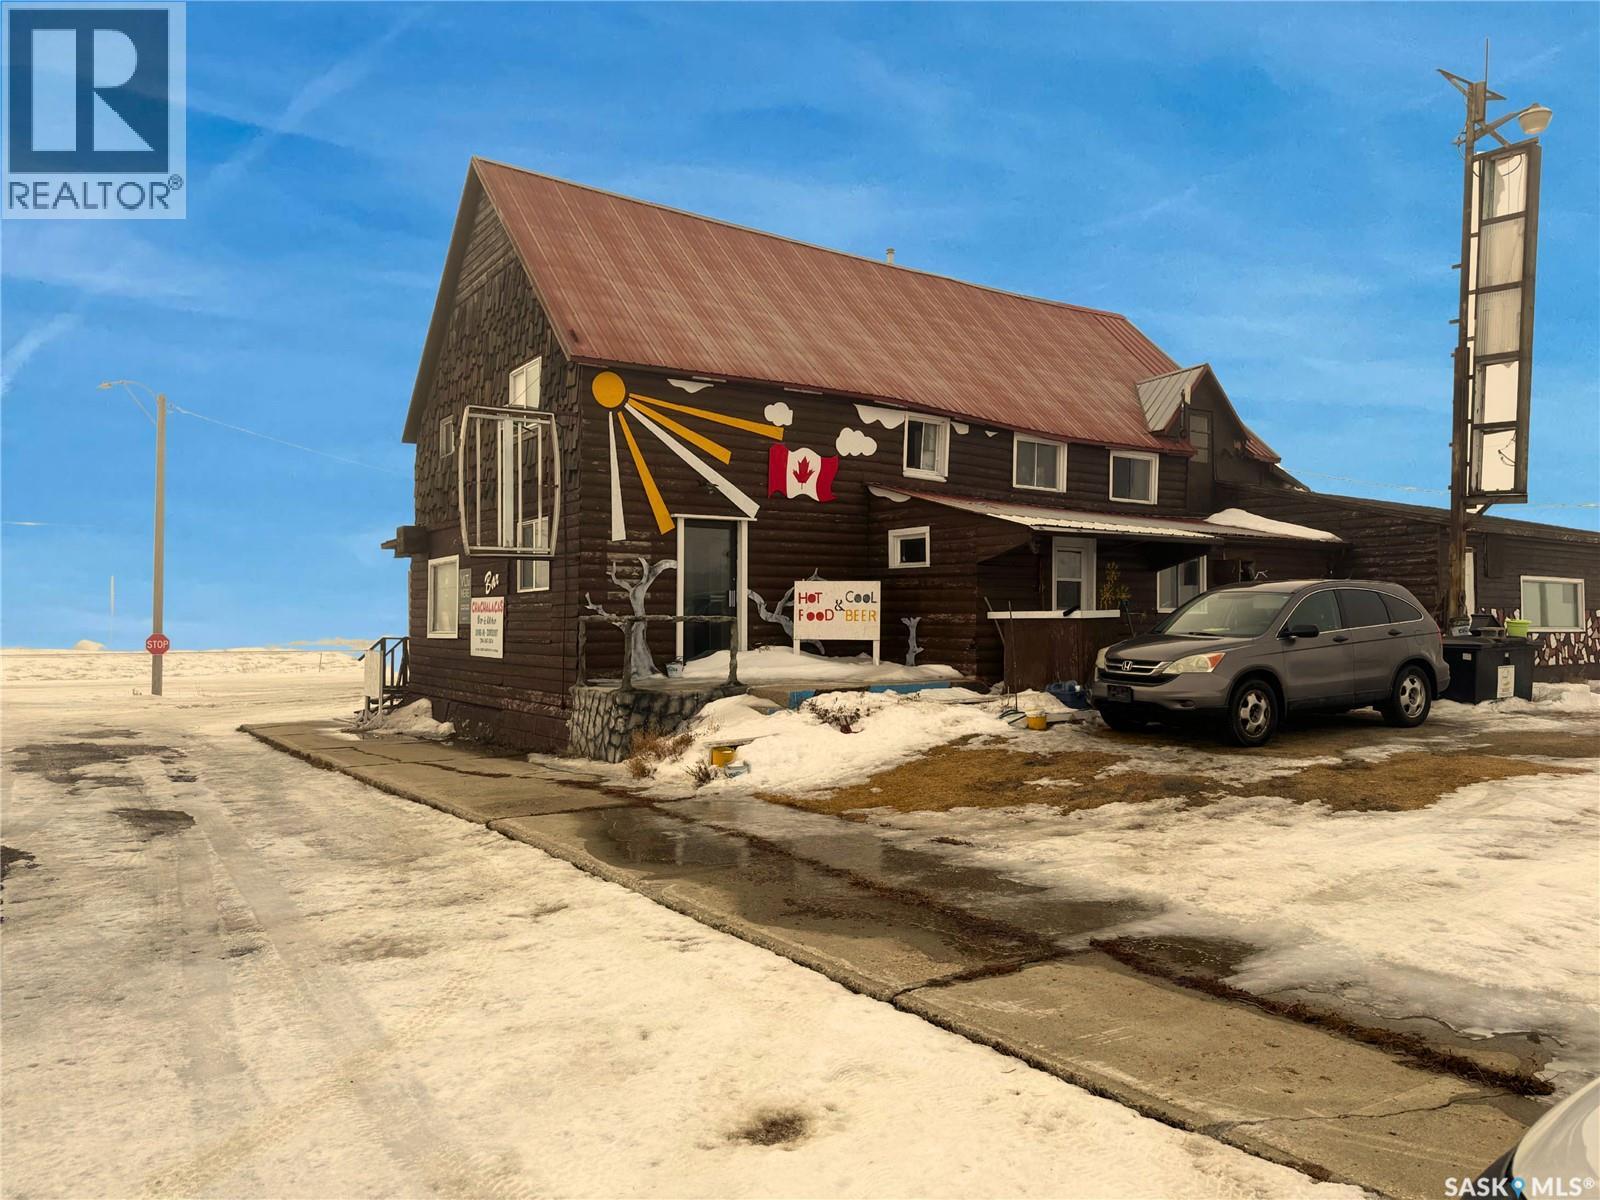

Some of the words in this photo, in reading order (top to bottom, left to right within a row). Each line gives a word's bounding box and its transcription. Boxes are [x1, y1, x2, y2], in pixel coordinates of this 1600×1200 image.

[485, 570, 500, 595] Bar
[798, 592, 823, 604] HOT
[845, 590, 878, 604] COOL
[834, 599, 845, 612] &
[798, 608, 835, 622] FOOD
[845, 609, 877, 622] BEER
[147, 640, 169, 649] STOP
